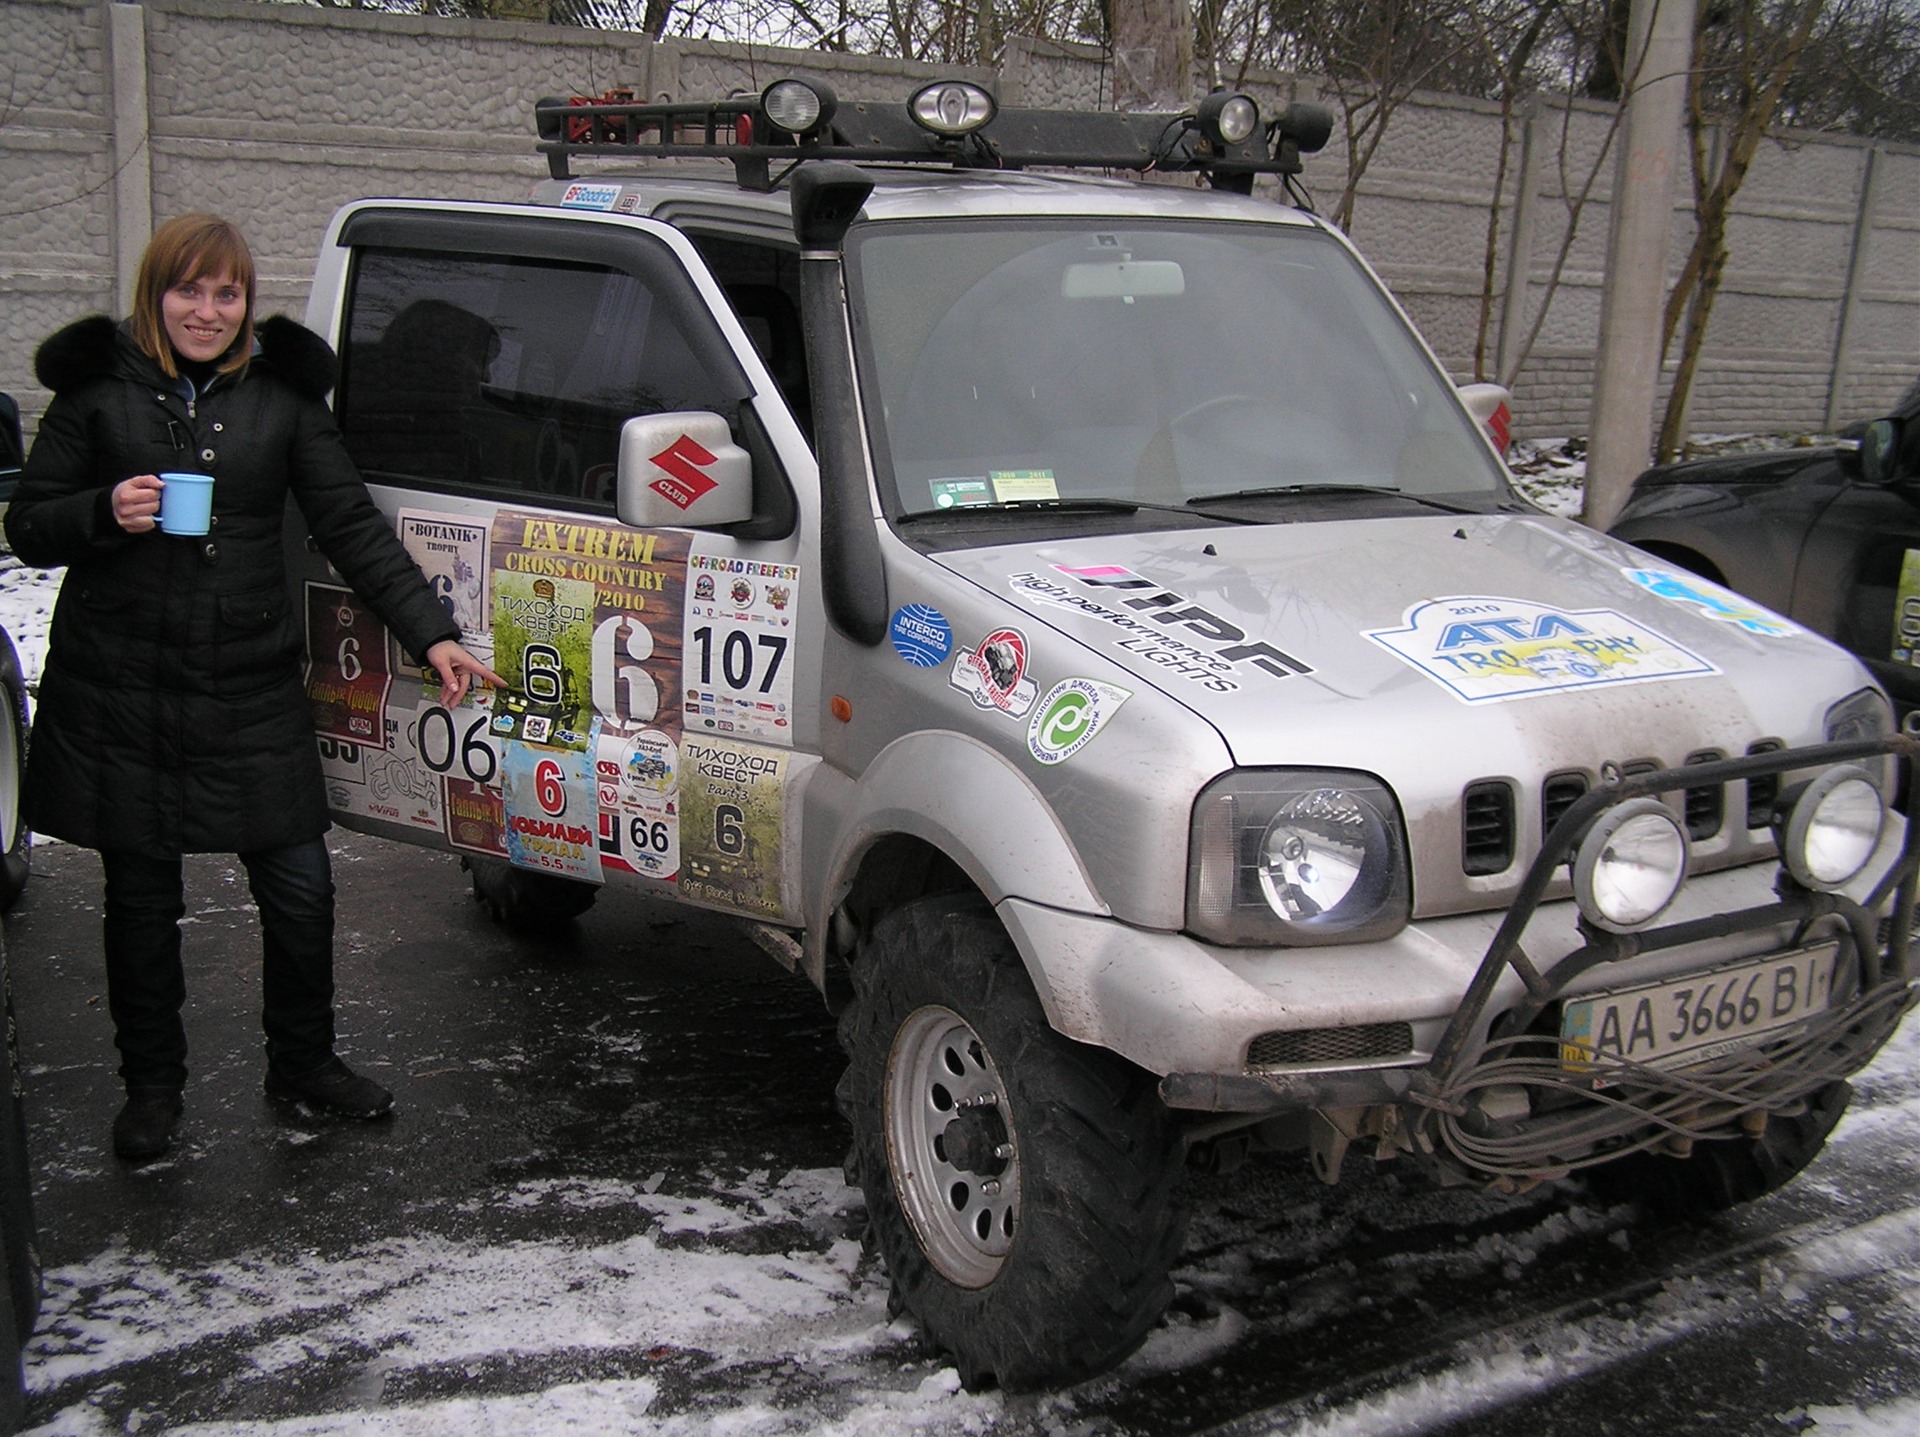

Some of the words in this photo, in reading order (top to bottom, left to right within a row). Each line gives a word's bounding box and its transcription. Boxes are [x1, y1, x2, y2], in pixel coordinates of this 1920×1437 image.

[658, 480, 689, 506] CLUB
[426, 541, 459, 553] TROPHY
[521, 519, 658, 565] EXTREM
[504, 551, 567, 578] CROSS
[571, 560, 667, 591] COUNTRY
[690, 555, 744, 574] OFFROAD
[746, 561, 799, 581] FREEFEST
[500, 596, 585, 623] ТИХОХОД
[514, 614, 570, 635] КВЕСТ
[1012, 572, 1068, 600] high
[1063, 594, 1233, 673] performance
[1449, 604, 1502, 616] 2010
[894, 624, 907, 635] TIRE
[907, 630, 947, 652] CORPORATION
[900, 616, 946, 642] INTERCO
[338, 637, 362, 681] 6
[523, 642, 562, 705] 6
[693, 626, 788, 693] 107
[1115, 637, 1239, 693] LIGHTS
[974, 687, 990, 704] 2010
[418, 706, 497, 783] 06
[686, 744, 778, 776] ТИХОХОД
[534, 758, 566, 817] 6
[697, 762, 760, 785] КВЕСТ
[706, 783, 736, 798] Part
[630, 816, 669, 853] 66
[714, 802, 745, 857] 6
[541, 855, 564, 870] 5.5
[1595, 996, 1656, 1060] AA
[1668, 972, 1763, 1043] 3666
